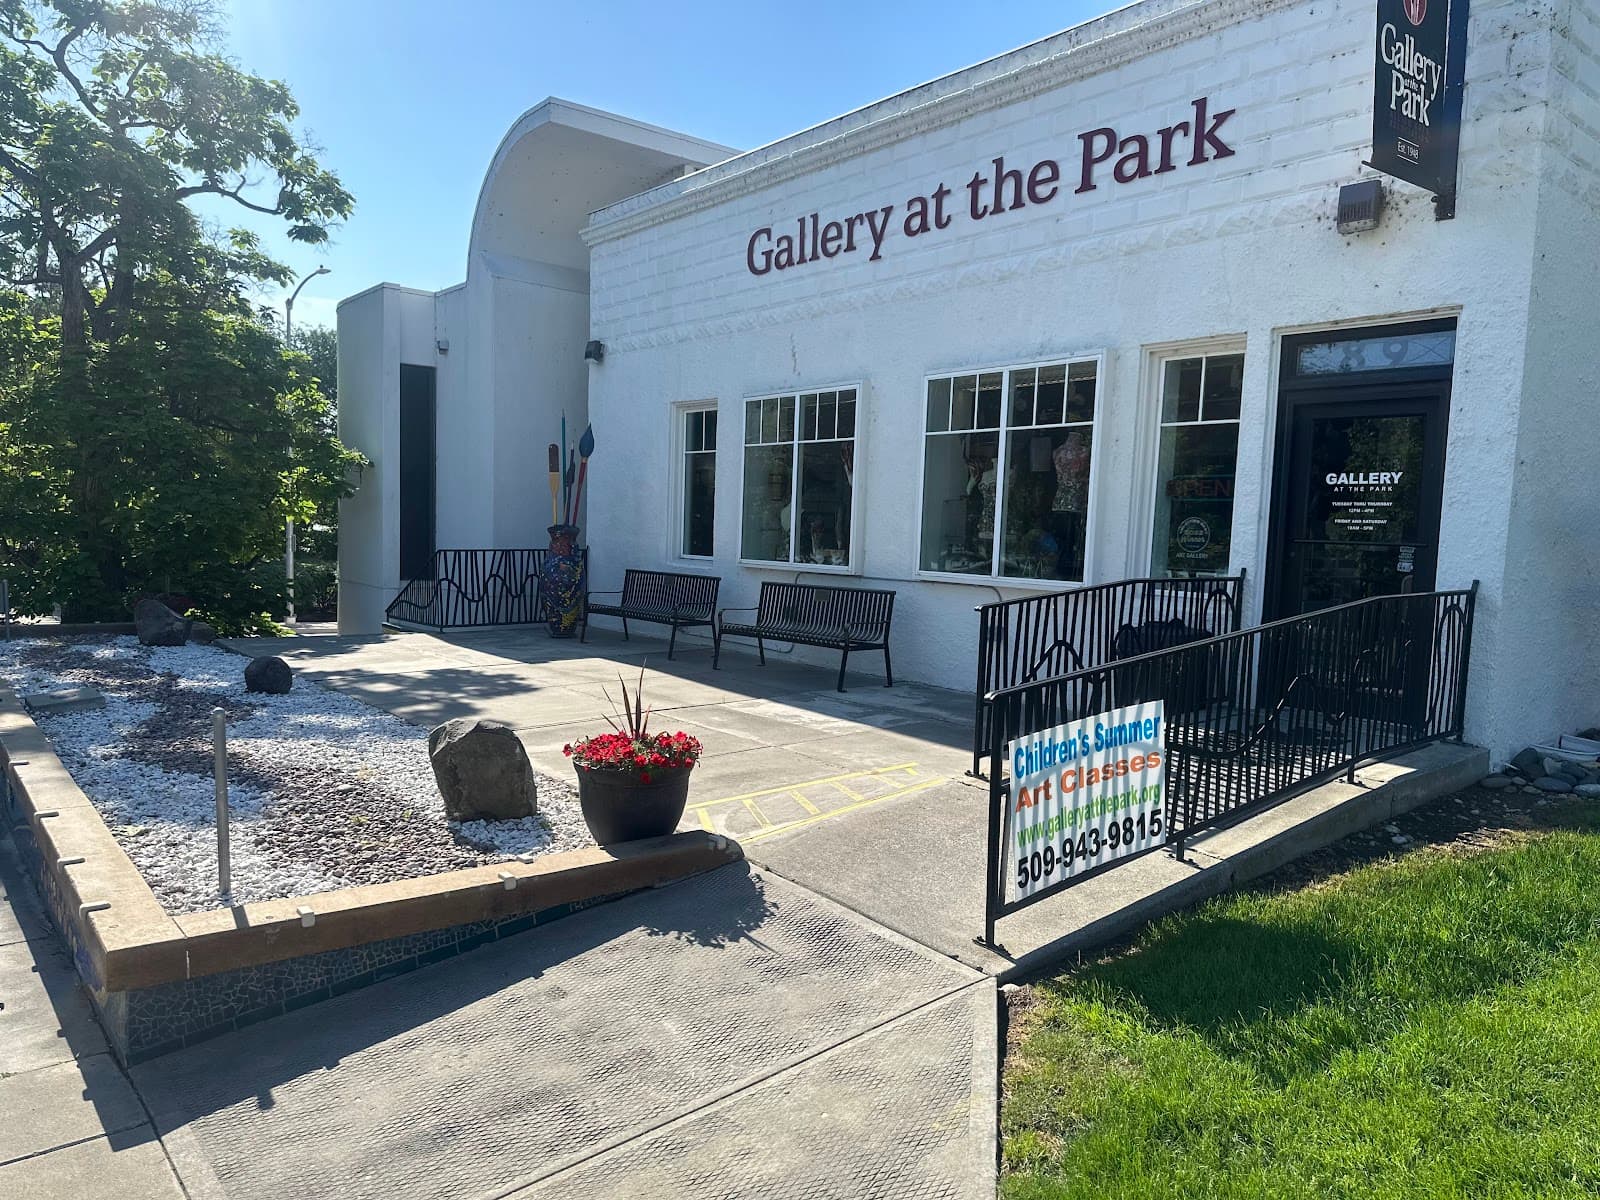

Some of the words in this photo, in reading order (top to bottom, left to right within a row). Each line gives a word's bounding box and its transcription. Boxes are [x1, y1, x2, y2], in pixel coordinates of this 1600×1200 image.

[1381, 22, 1442, 101] Gallery
[1390, 69, 1430, 127] Park
[747, 204, 894, 276] Gallery
[903, 182, 952, 237] at
[966, 156, 1060, 220] the
[1074, 96, 1236, 195] Park
[1325, 471, 1404, 485] GALLERY
[1186, 552, 1209, 560] GALLERY
[1014, 728, 1090, 780] Children's
[1094, 715, 1161, 753] Summer
[1015, 778, 1053, 813] Art
[1060, 751, 1161, 794] Classes
[1017, 783, 1161, 848] www.galleryatthepark.org
[1017, 808, 1163, 889] 509-943-9815
